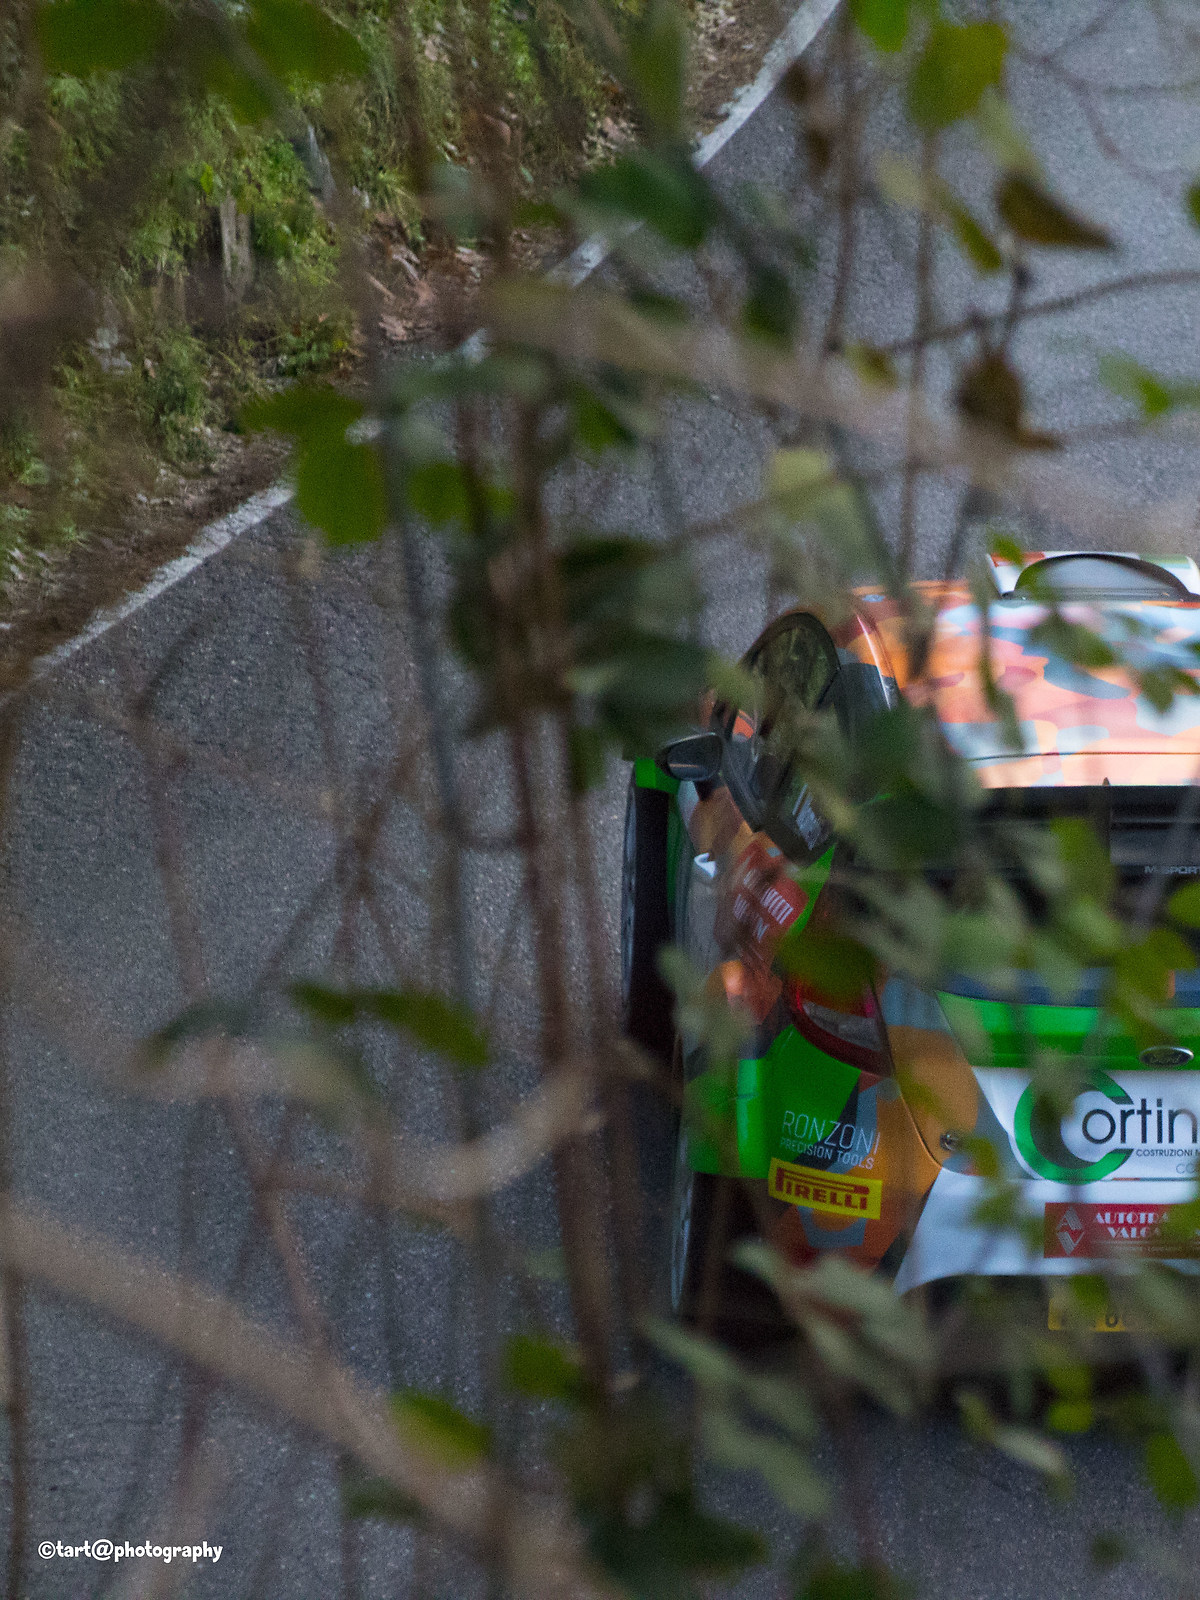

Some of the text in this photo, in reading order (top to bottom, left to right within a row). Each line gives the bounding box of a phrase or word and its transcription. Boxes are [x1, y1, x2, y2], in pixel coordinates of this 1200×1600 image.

[781, 1109, 881, 1156] RONZONI
[780, 1136, 874, 1170] PRECISION TOOLS
[1136, 1148, 1193, 1157] COSTRUZIONI
[775, 1167, 870, 1211] PIRELLI
